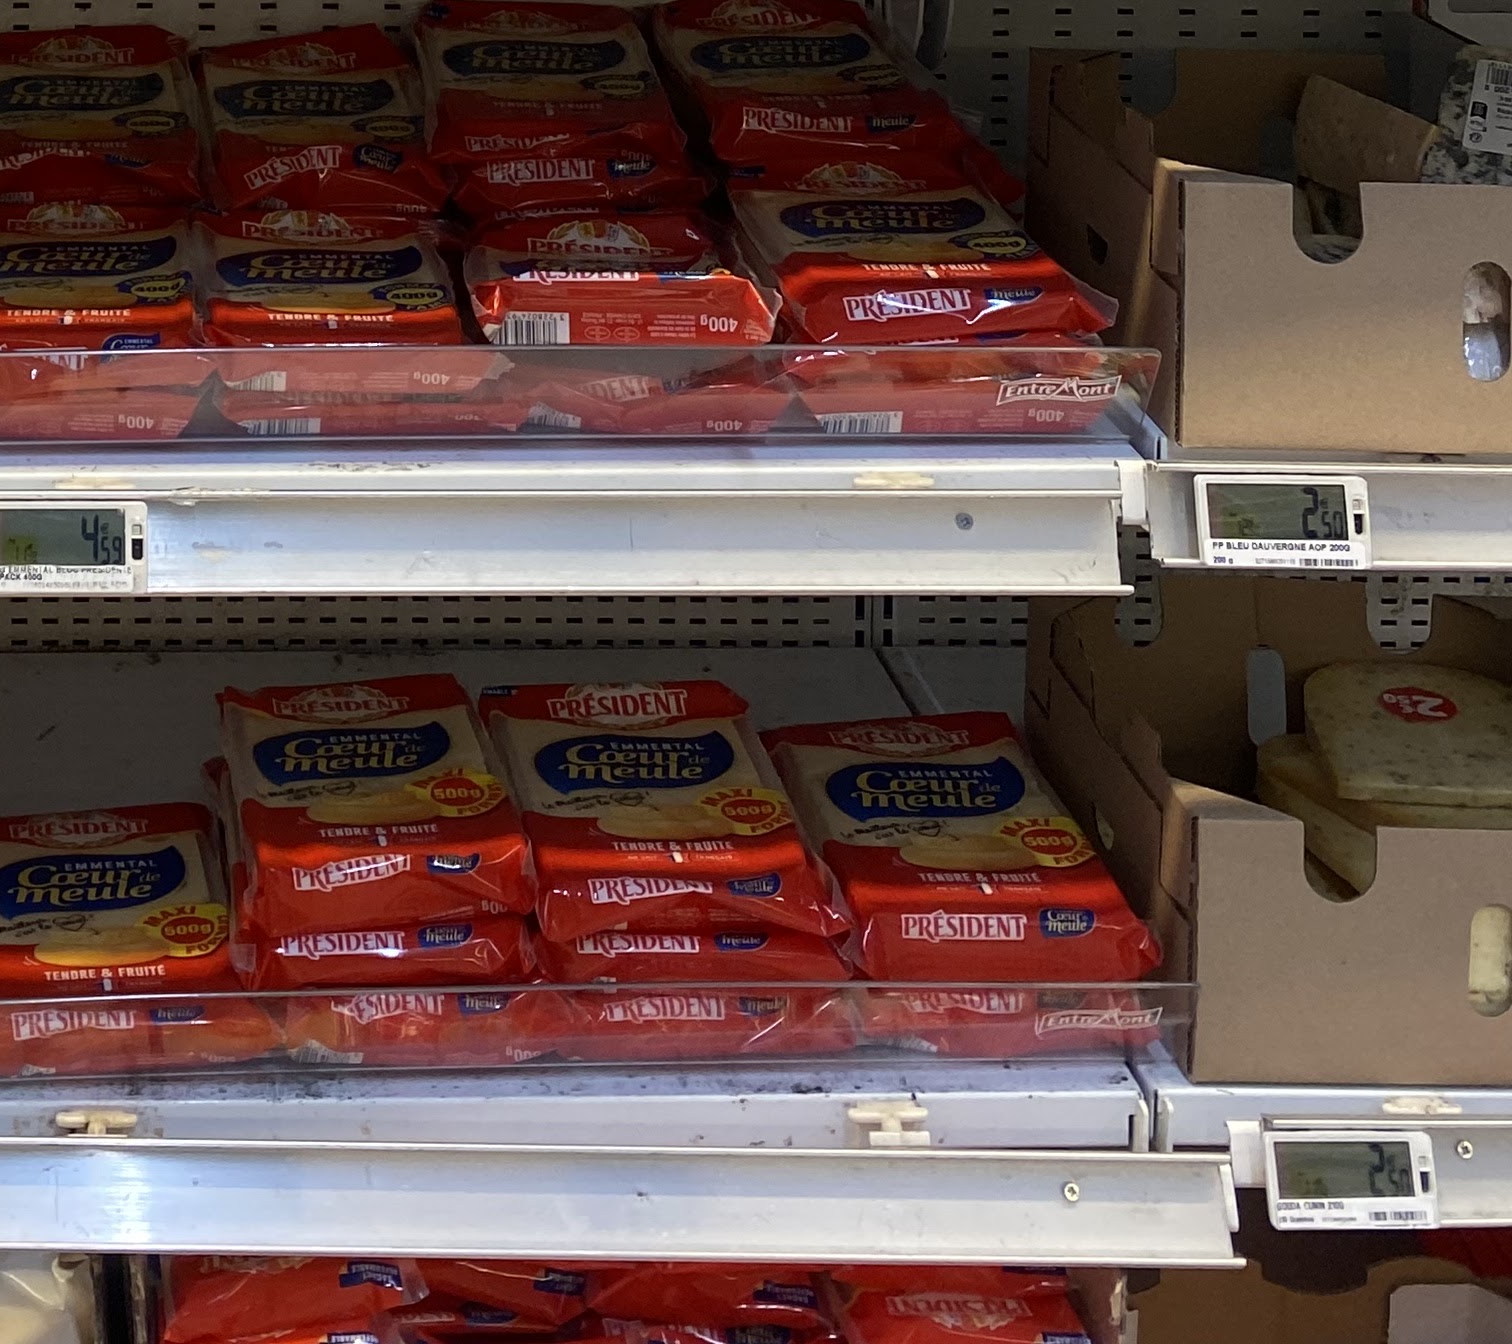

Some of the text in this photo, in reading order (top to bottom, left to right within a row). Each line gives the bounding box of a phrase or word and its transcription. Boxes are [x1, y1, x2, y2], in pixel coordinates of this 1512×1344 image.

[7, 308, 60, 317] TENDRE
[1005, 379, 1112, 401] EntreMont
[1226, 542, 1249, 550] BLEU
[899, 769, 993, 779] EMMENTAL
[851, 791, 997, 811] meule
[999, 818, 1050, 837] MAXI
[1026, 834, 1073, 847] 500g
[918, 872, 971, 883] TENDRE
[903, 912, 1026, 941] PRÉSIDENT
[1047, 1008, 1153, 1030] EntreMont
